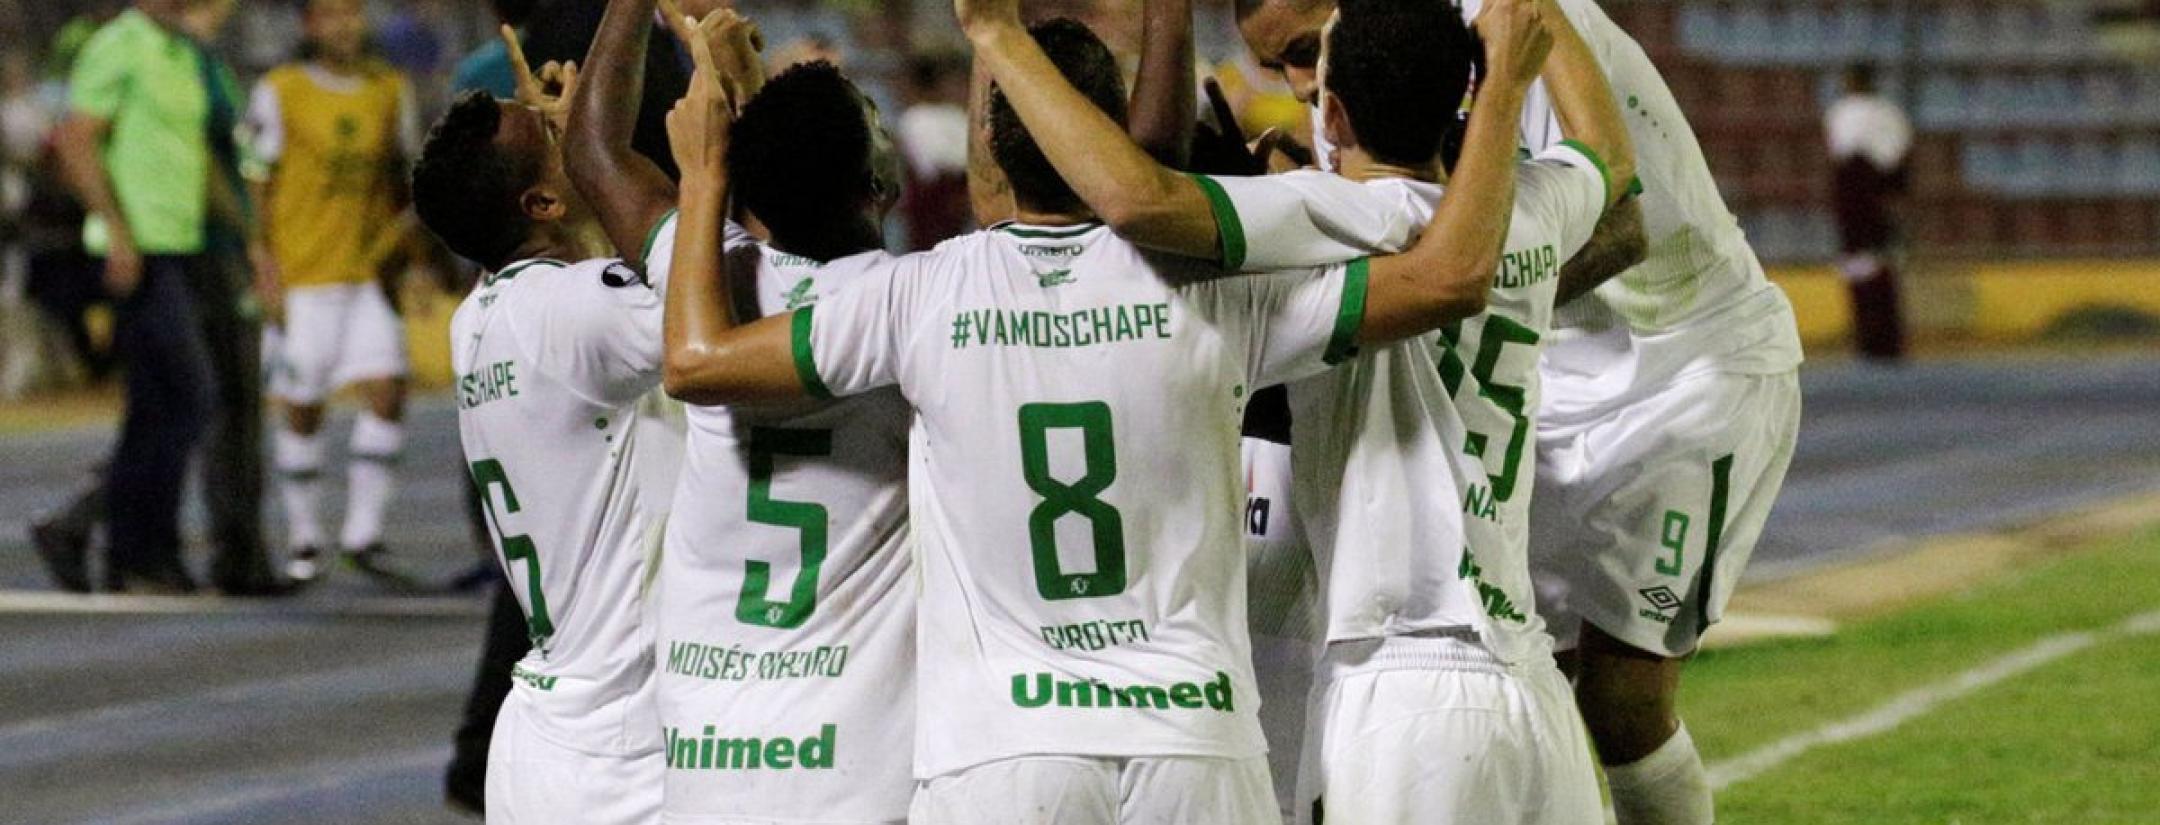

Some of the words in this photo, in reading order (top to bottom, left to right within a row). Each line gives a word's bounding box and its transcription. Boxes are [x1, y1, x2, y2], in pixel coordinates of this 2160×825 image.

[1493, 244, 1558, 289] CHAP
[951, 303, 1172, 348] #VAMOSCHAPE
[1017, 399, 1127, 601] 8
[736, 426, 829, 630] 5
[1655, 510, 1689, 577] 9
[666, 640, 756, 681] MOISÉS
[1011, 670, 1233, 712] Unimed
[663, 723, 838, 770] Unimed
